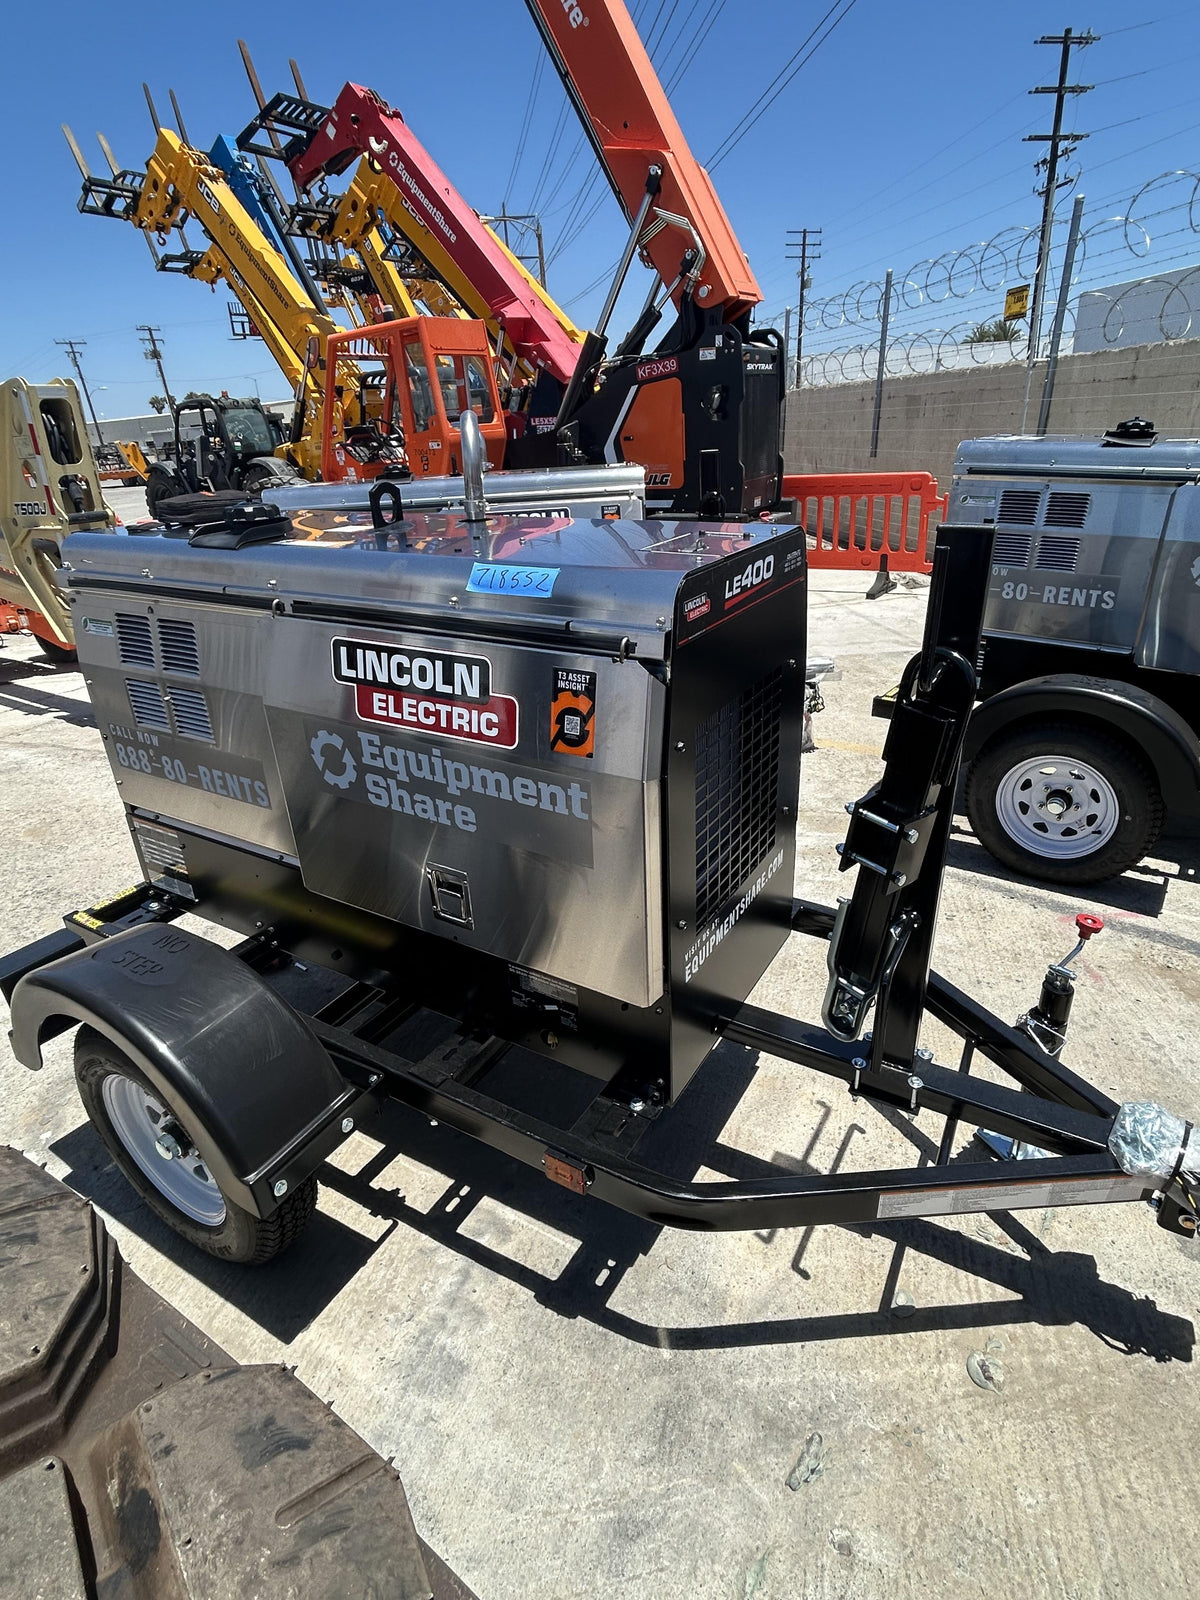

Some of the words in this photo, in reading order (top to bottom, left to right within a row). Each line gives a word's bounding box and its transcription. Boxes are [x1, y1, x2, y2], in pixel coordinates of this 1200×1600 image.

[197, 182, 220, 213] JCB
[396, 160, 457, 244] EquipmentShare
[235, 233, 290, 310] EquipmentShare
[637, 358, 677, 379] KF3X39
[644, 473, 672, 486] JLG
[476, 567, 550, 593] 718552
[724, 554, 775, 600] LE400
[992, 567, 1009, 577] OW
[684, 594, 706, 613] LINCOLN
[689, 603, 709, 620] ELECTRIC
[339, 646, 480, 699] LINCOLN
[557, 671, 567, 680] T3
[568, 672, 591, 684] ASSET
[557, 680, 586, 691] INSIGHT
[372, 692, 500, 738] ELECTRIC
[109, 723, 134, 740] CALL
[136, 729, 160, 748] NOW
[116, 742, 270, 808] 888-80-RENTS
[356, 730, 590, 821] Equipment
[364, 773, 478, 833] Share
[685, 848, 784, 984] EQUIPMENTSHARE.COM
[152, 932, 191, 954] NO
[684, 939, 701, 962] VISIT
[702, 929, 710, 942] US
[111, 948, 165, 977] STEP
